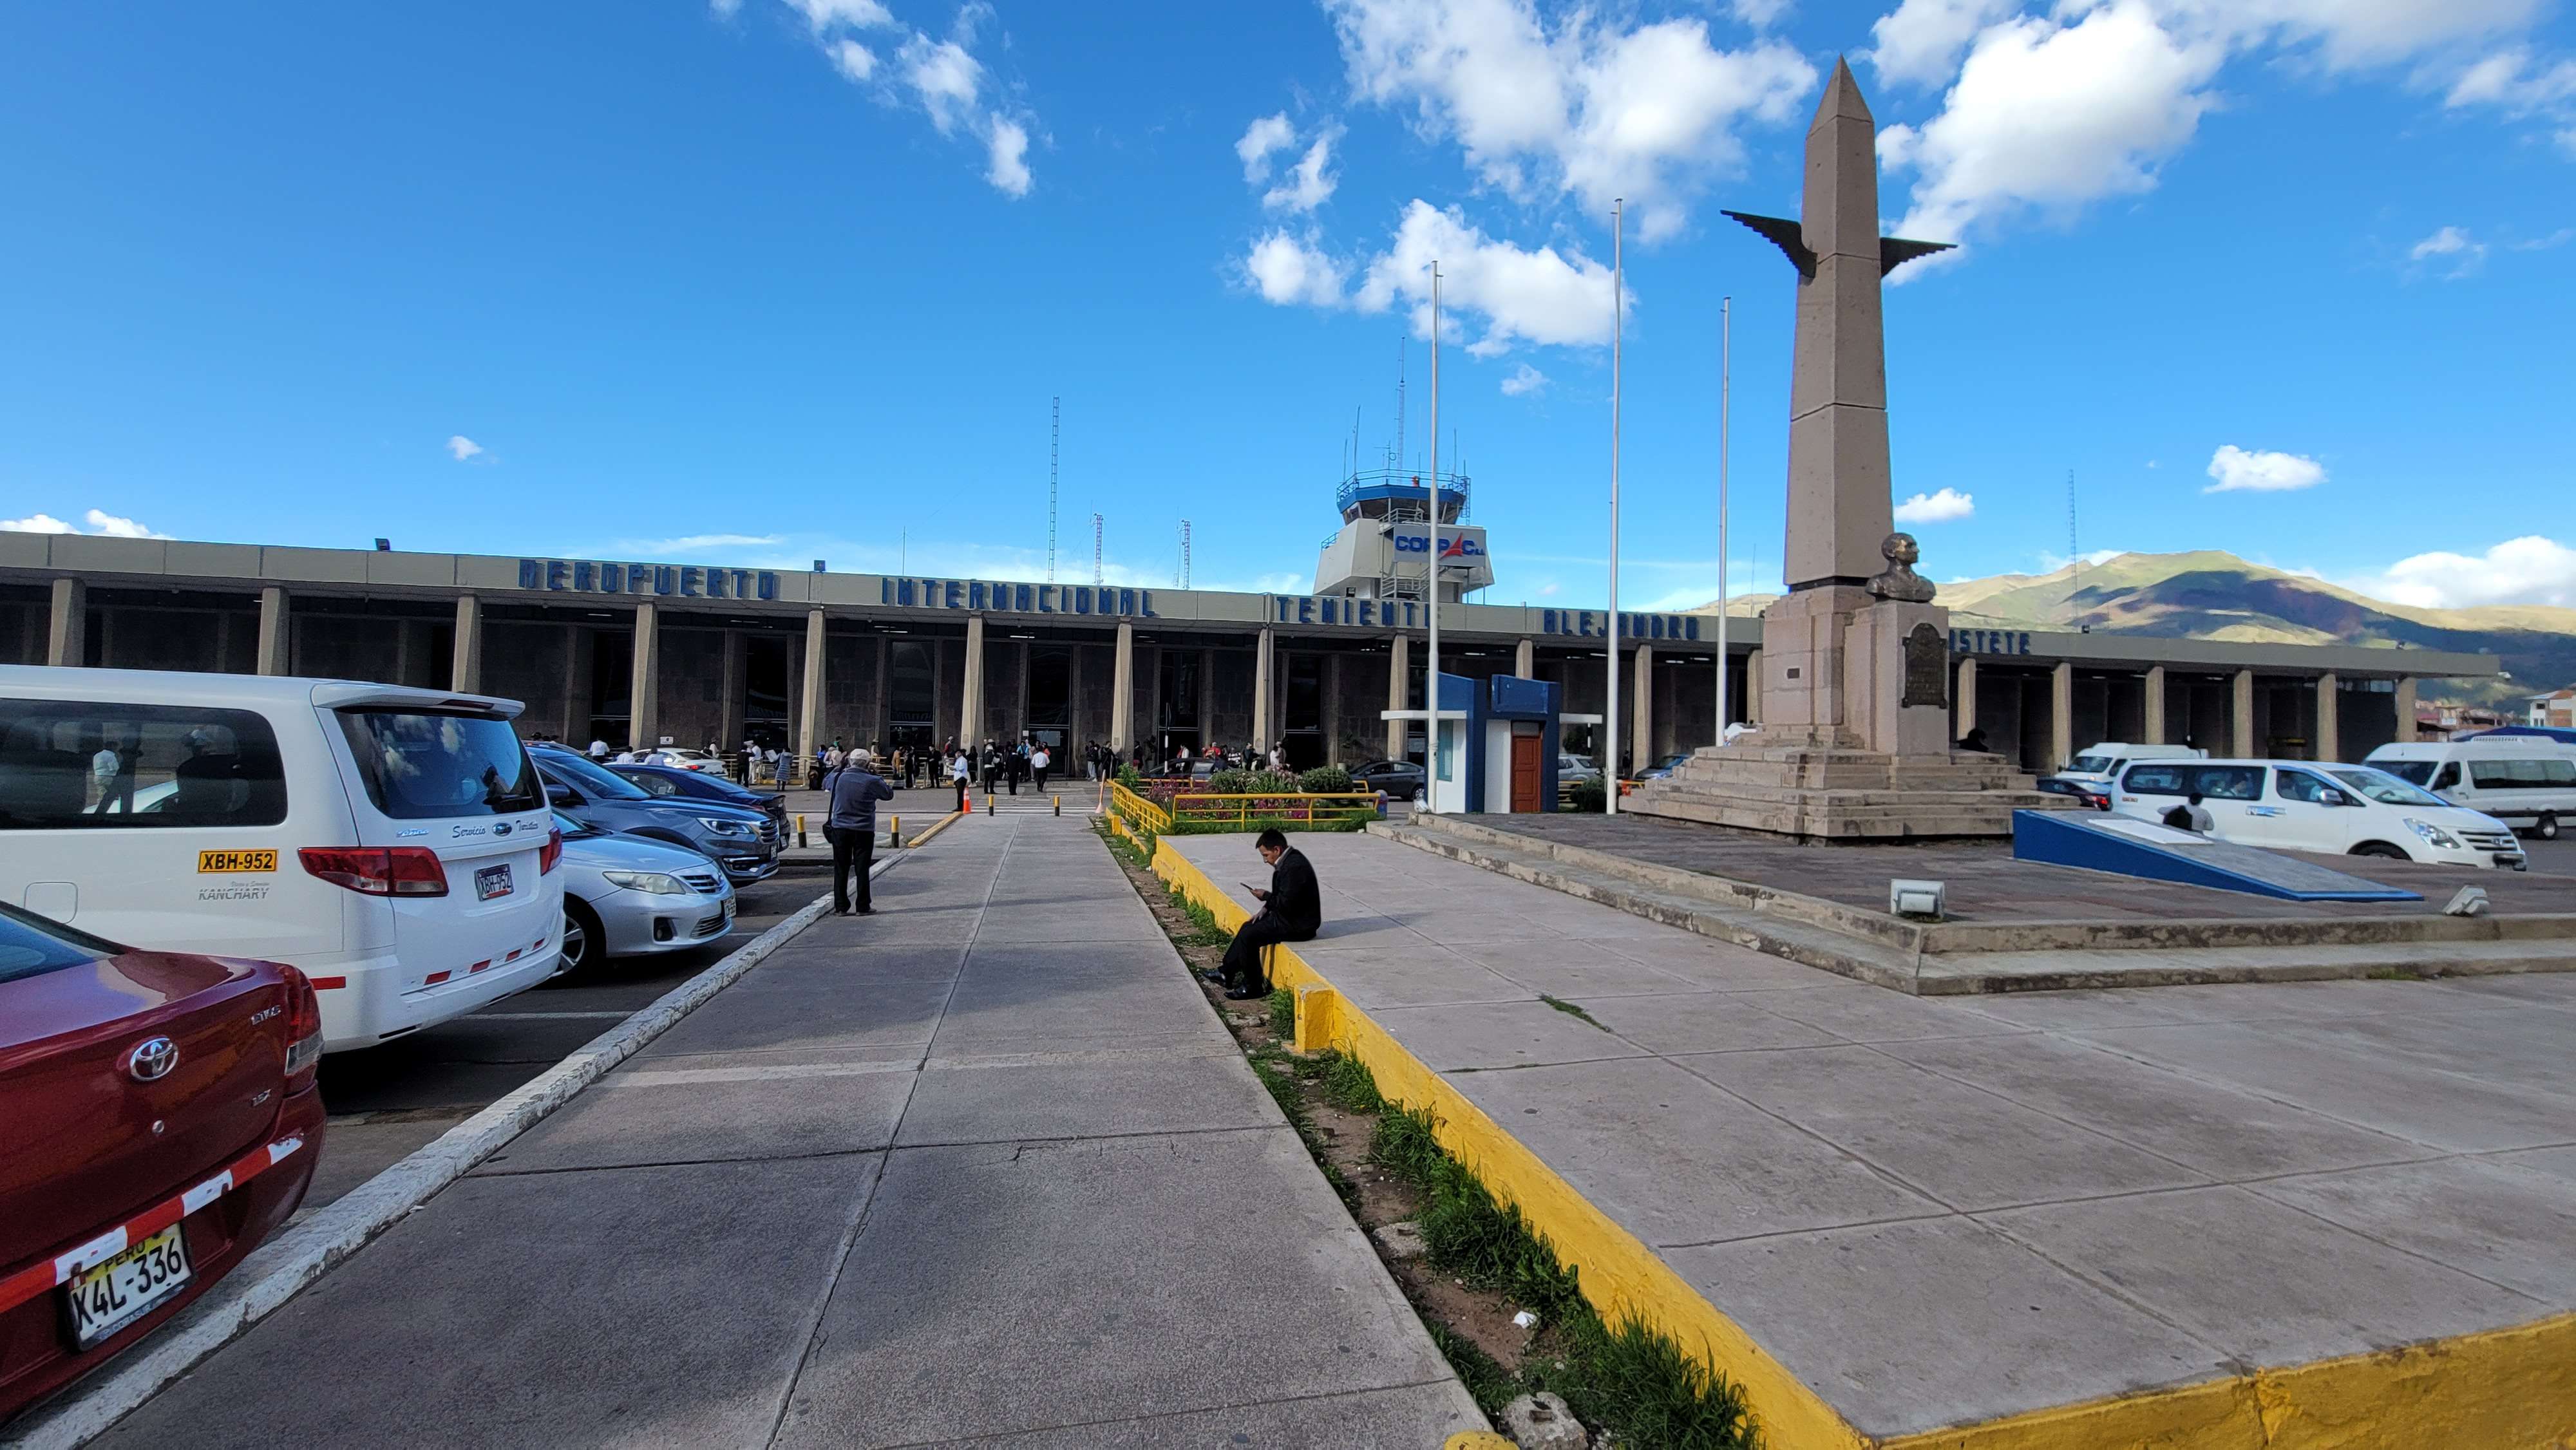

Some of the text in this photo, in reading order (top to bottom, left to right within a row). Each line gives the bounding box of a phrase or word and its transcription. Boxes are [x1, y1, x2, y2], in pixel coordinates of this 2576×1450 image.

[518, 559, 773, 599] AEROPUERTO
[881, 577, 1155, 617] INTERNACIONAL
[1544, 608, 1699, 641] ALEJANDRO
[451, 825, 486, 838] Servicio
[202, 852, 273, 870] XBH-952
[479, 872, 512, 894] XBH-952
[198, 887, 270, 901] KANCHARY
[72, 1238, 182, 1332] X4L-336
